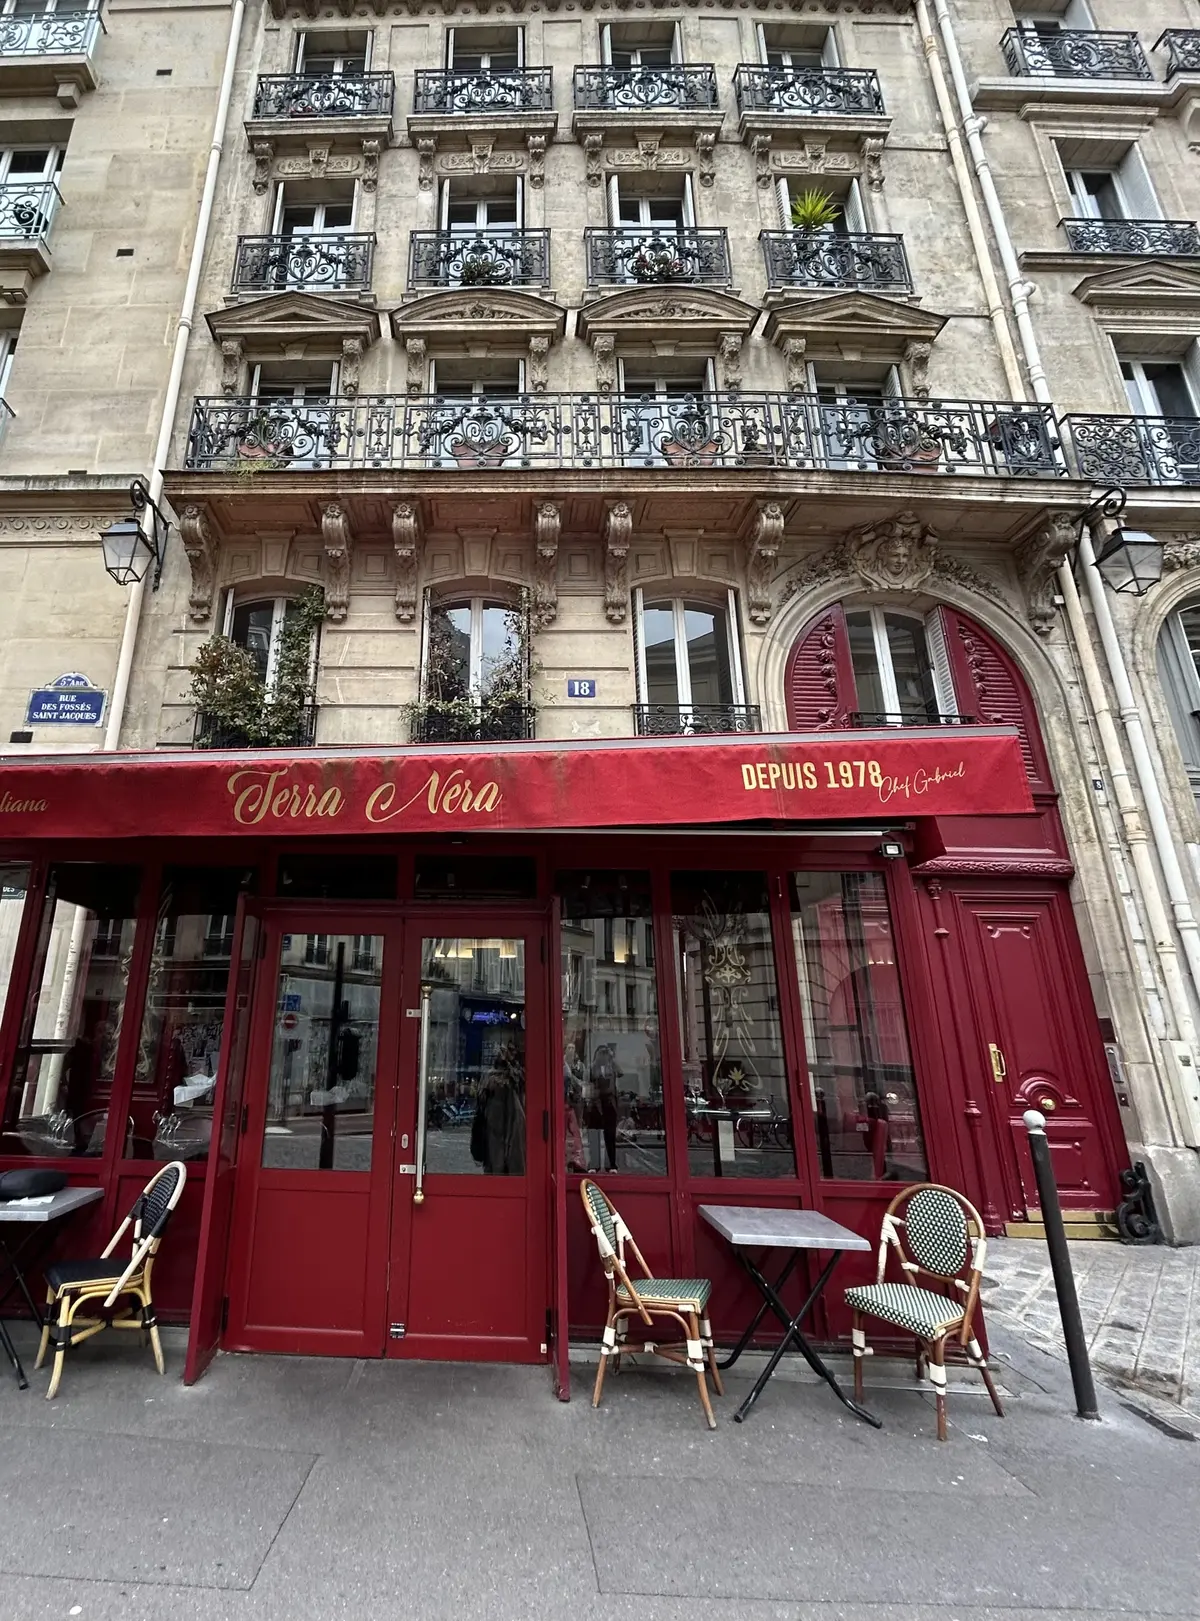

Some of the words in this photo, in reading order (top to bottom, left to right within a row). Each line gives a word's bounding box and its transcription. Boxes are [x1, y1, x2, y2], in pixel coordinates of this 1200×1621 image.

[573, 681, 590, 696] 18
[59, 694, 77, 702] RUE
[41, 703, 57, 711] DES
[59, 702, 92, 711] FOSSÉS
[32, 711, 59, 719] SAINT
[59, 712, 97, 721] JACQUES
[741, 762, 818, 790] DEPUIS
[823, 760, 882, 789] 1978
[878, 776, 911, 803] Chef
[913, 761, 966, 794] Gabriel
[227, 767, 345, 825] Terra
[410, 769, 503, 814] Nera
